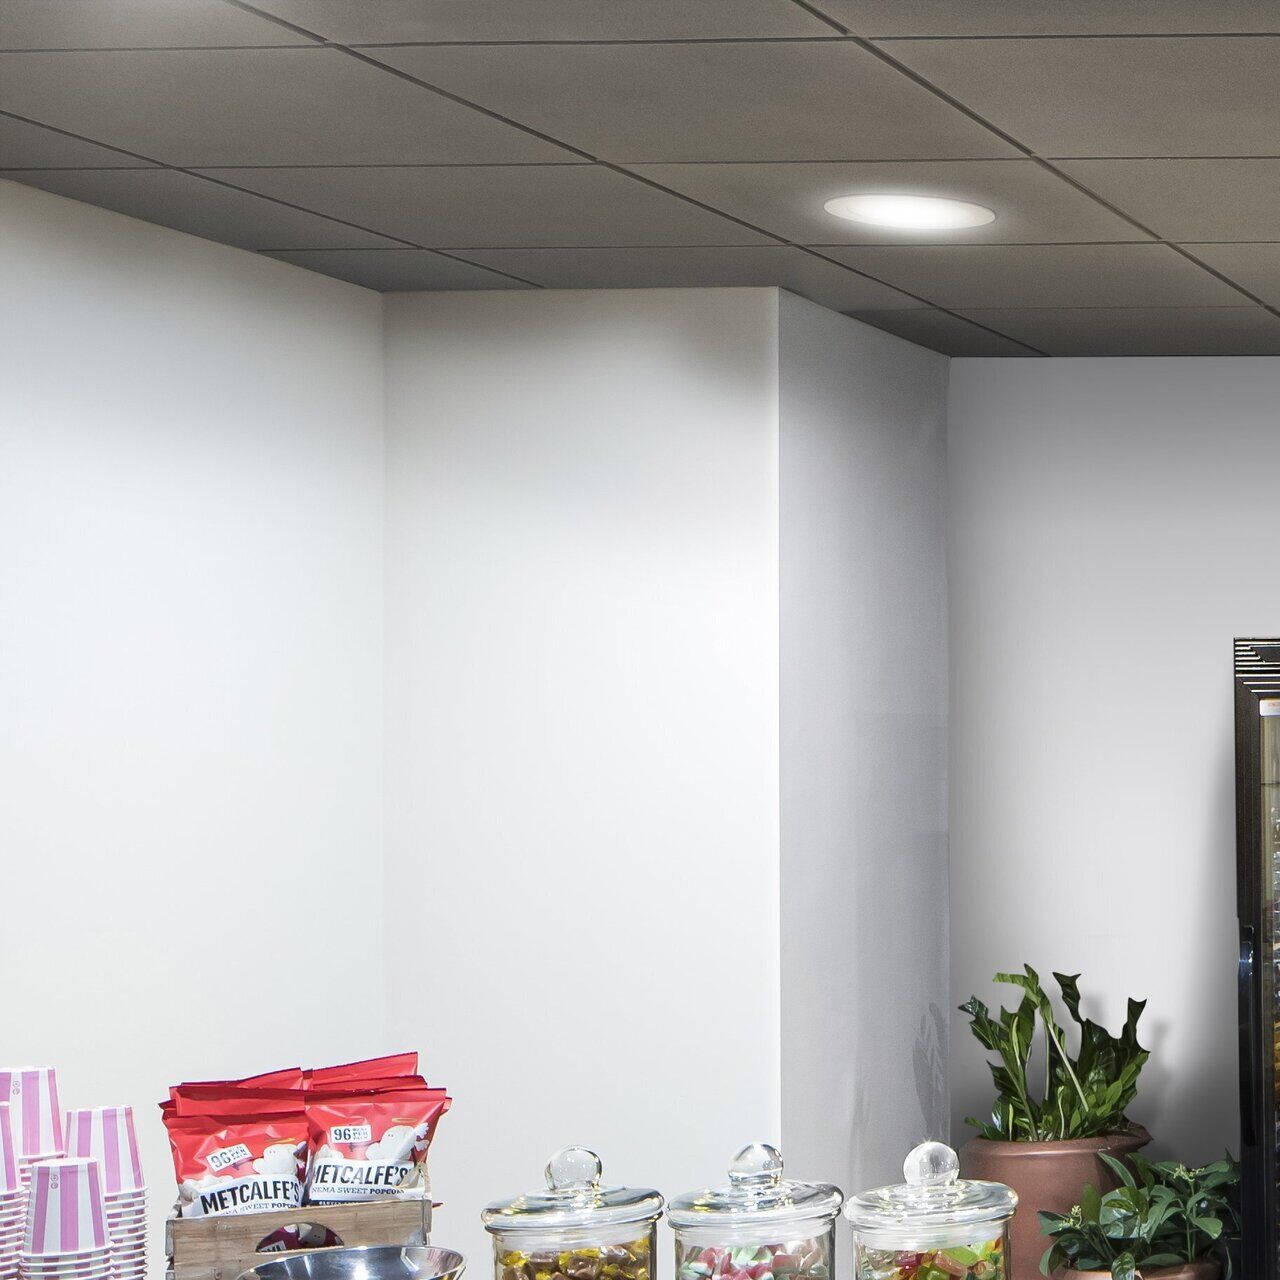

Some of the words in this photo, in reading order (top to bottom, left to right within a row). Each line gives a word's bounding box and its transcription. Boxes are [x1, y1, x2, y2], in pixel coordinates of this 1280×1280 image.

[334, 1128, 351, 1141] 96
[210, 1151, 232, 1169] 96
[200, 1180, 299, 1215] METCALFE'S
[336, 1187, 369, 1195] SWEET
